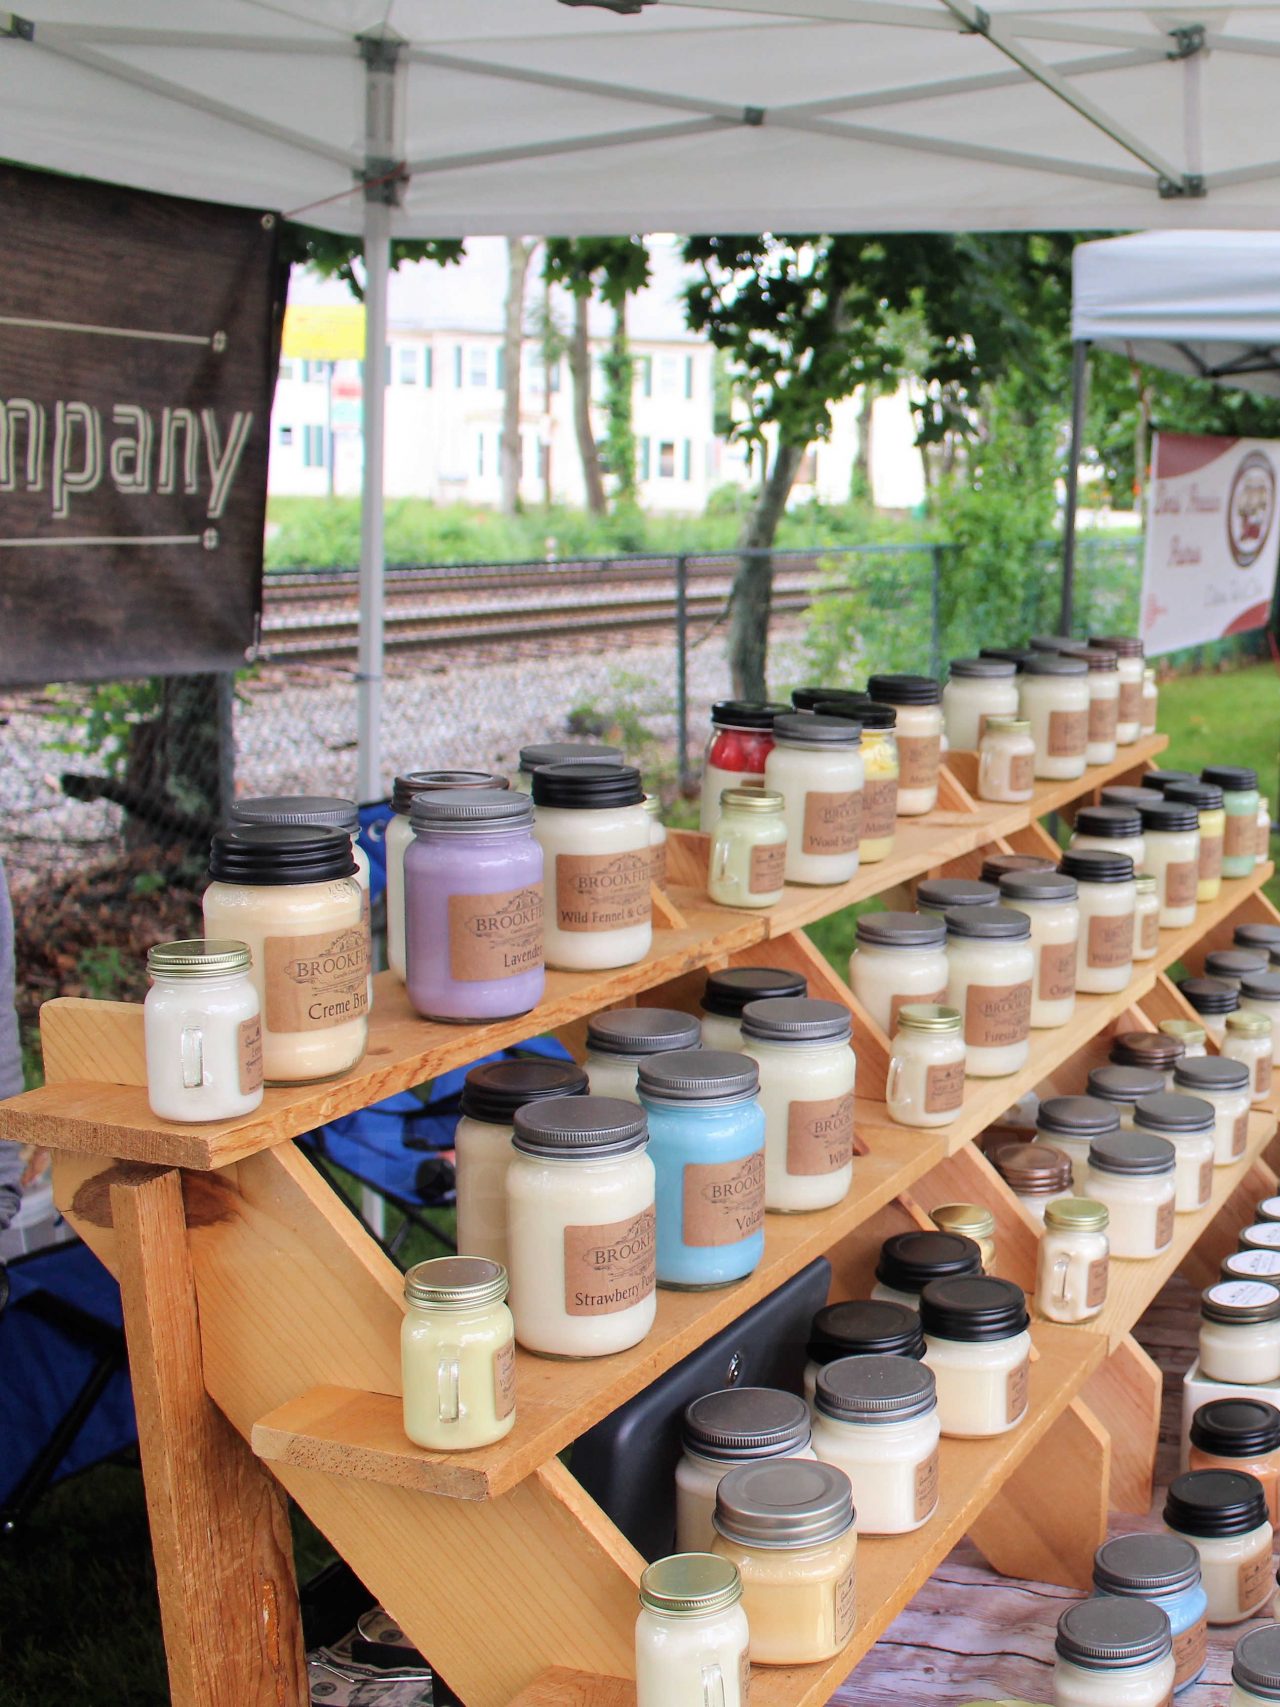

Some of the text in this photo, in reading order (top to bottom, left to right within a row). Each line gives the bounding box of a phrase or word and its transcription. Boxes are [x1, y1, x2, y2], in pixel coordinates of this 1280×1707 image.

[561, 910, 588, 924] Wild
[592, 909, 625, 923] Fennel
[308, 1000, 351, 1020] Creme
[574, 1285, 640, 1307] Strawberry
